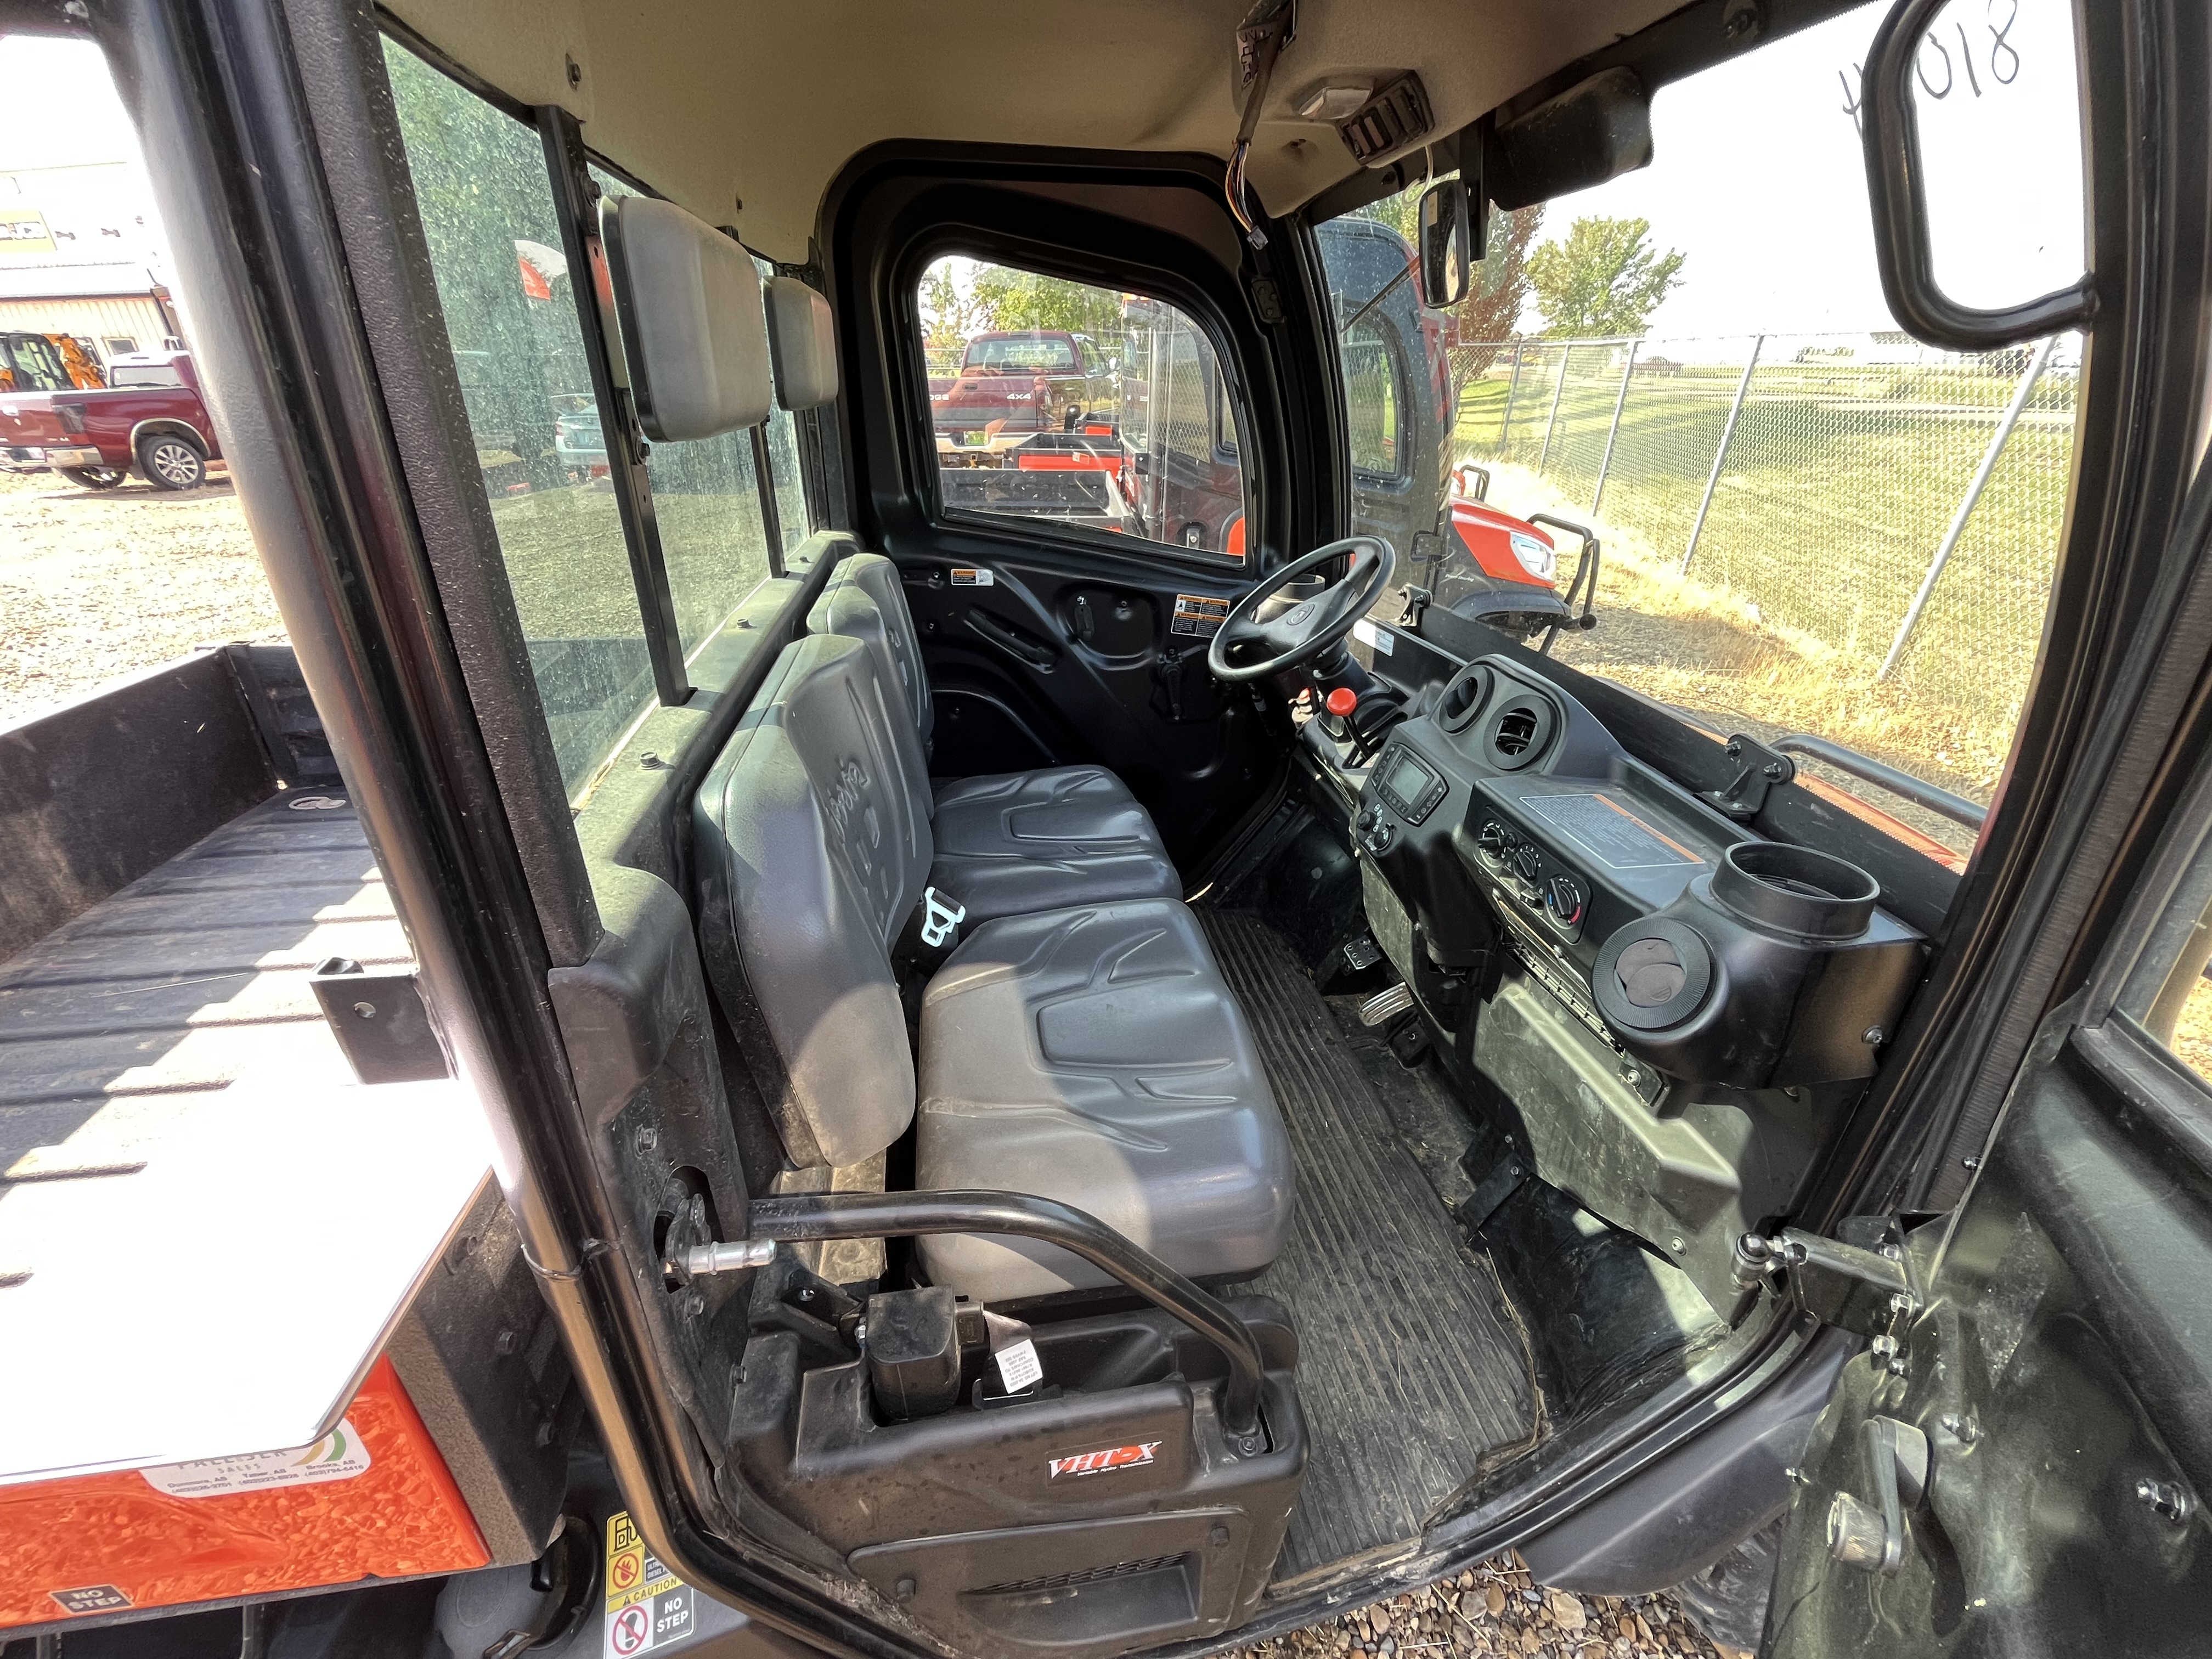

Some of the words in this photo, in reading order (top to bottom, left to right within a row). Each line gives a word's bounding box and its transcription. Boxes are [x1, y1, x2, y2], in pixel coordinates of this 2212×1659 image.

[1048, 1440, 1163, 1480] VHT-X
[71, 1589, 104, 1600] NO
[634, 1577, 677, 1601] CAUTION
[67, 1596, 122, 1610] STEP
[664, 1596, 683, 1615] NO
[656, 1610, 689, 1633] STEP
